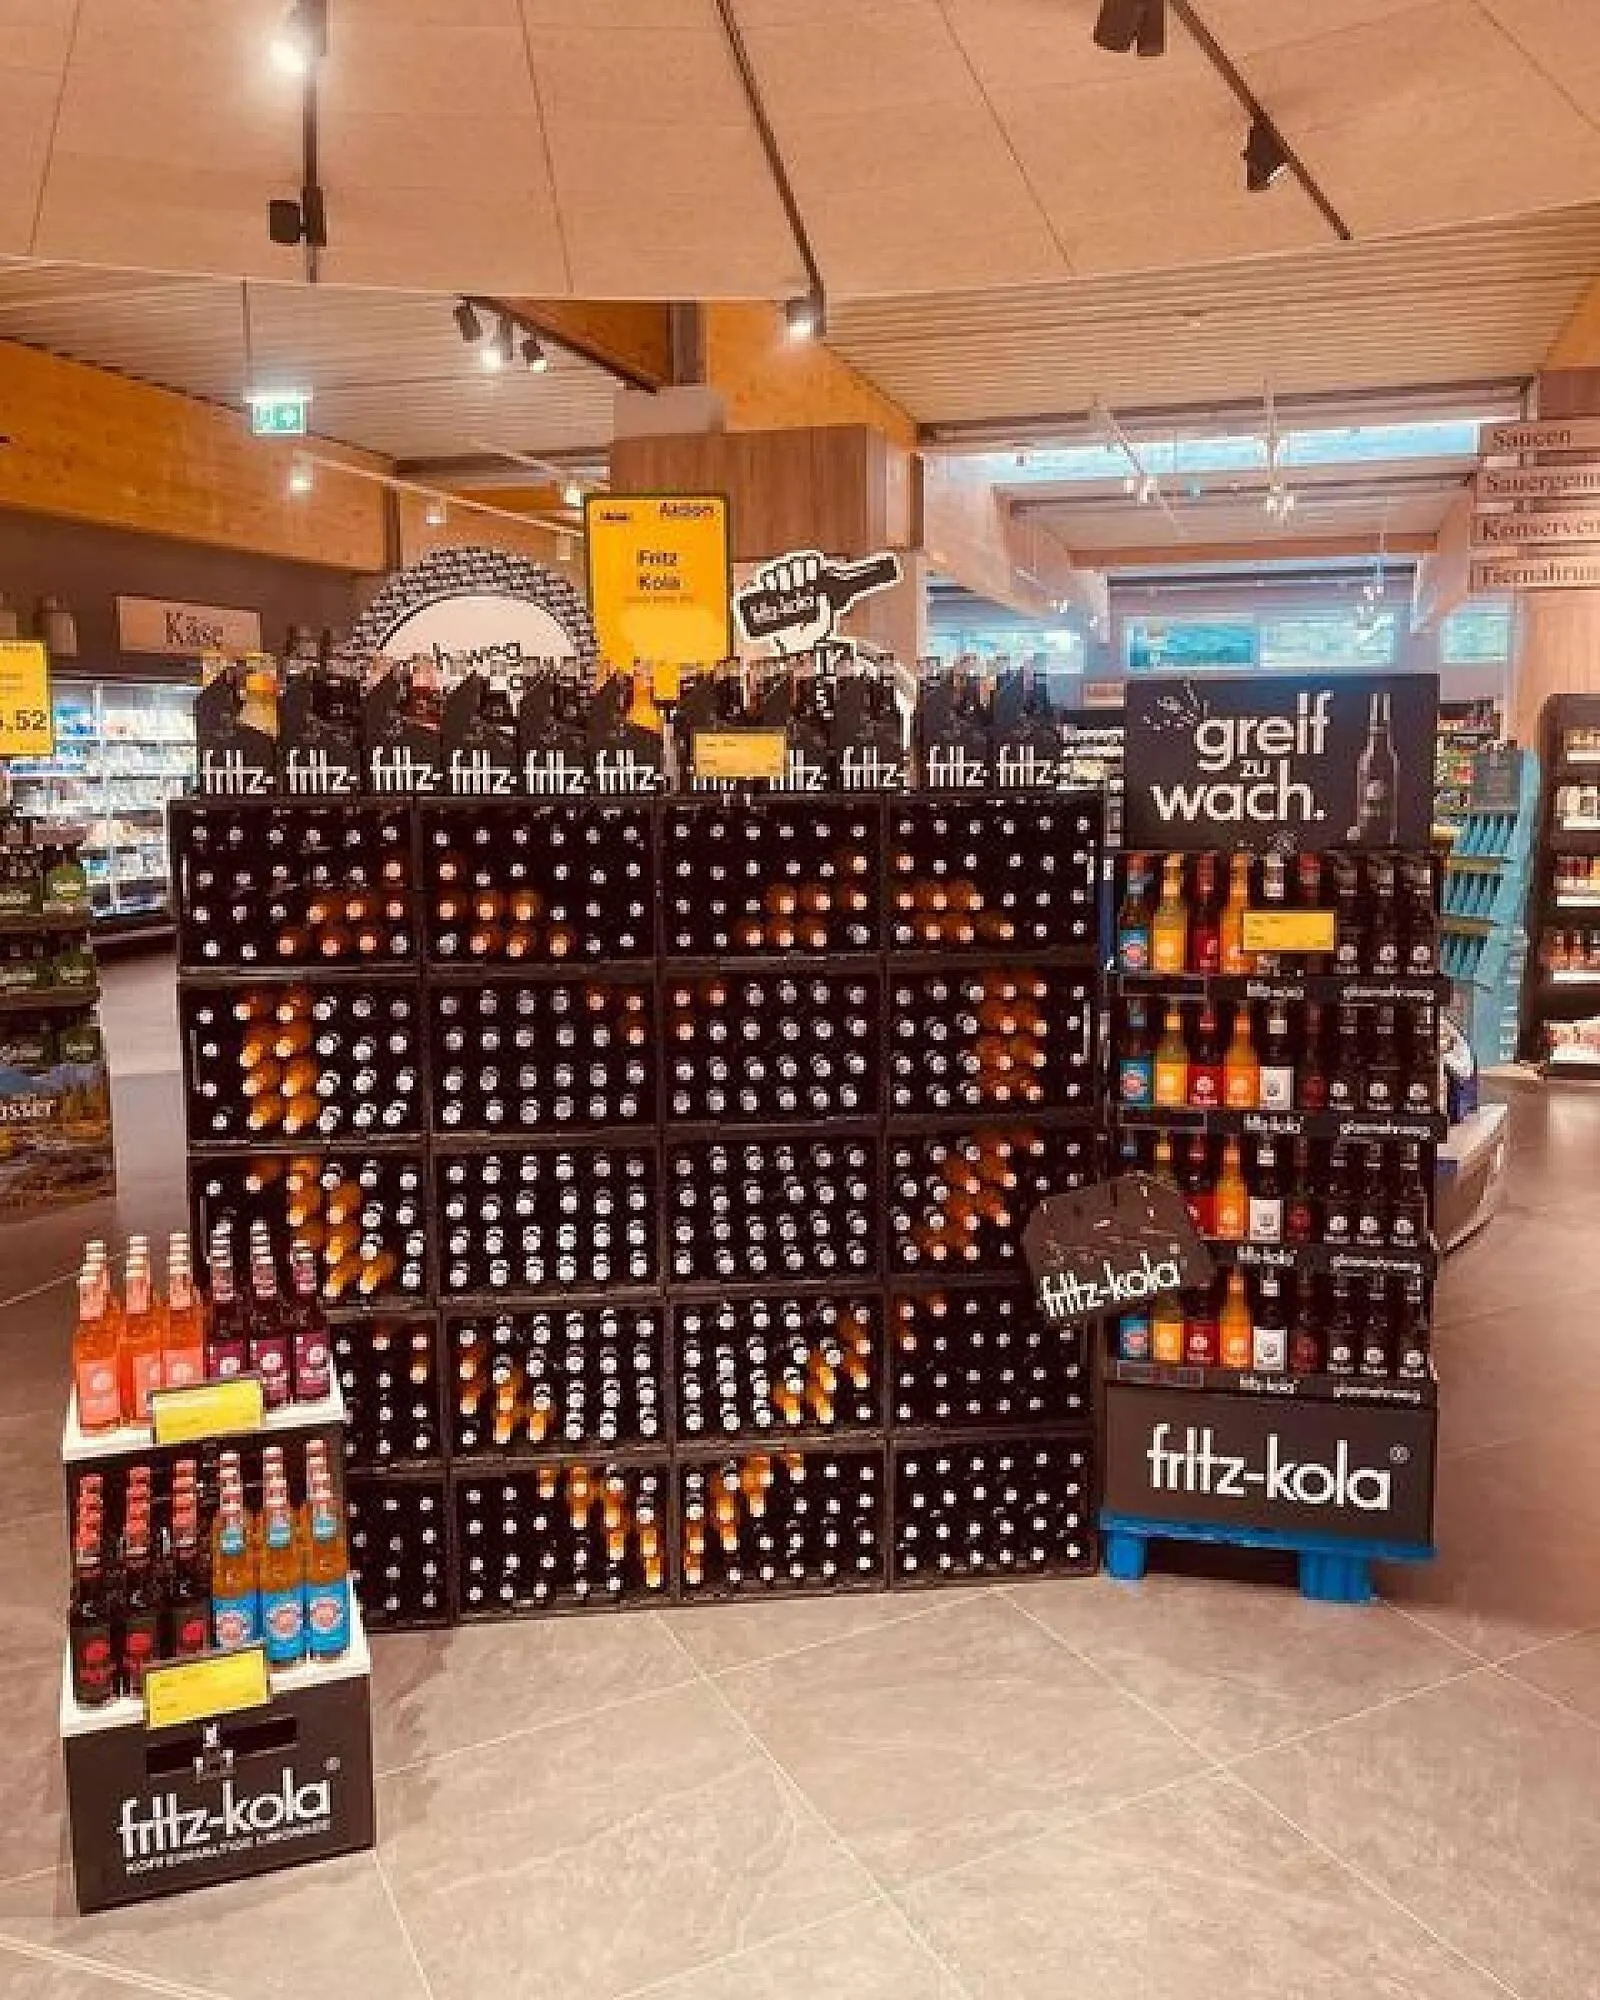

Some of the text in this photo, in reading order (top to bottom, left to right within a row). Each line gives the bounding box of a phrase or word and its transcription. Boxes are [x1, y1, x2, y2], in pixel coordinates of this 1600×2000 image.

[637, 549, 678, 567] Fritz
[638, 575, 682, 592] Kola
[0, 708, 48, 731] .52
[1194, 689, 1335, 771] greif
[1239, 759, 1271, 778] zu
[1149, 759, 1328, 821] wach.
